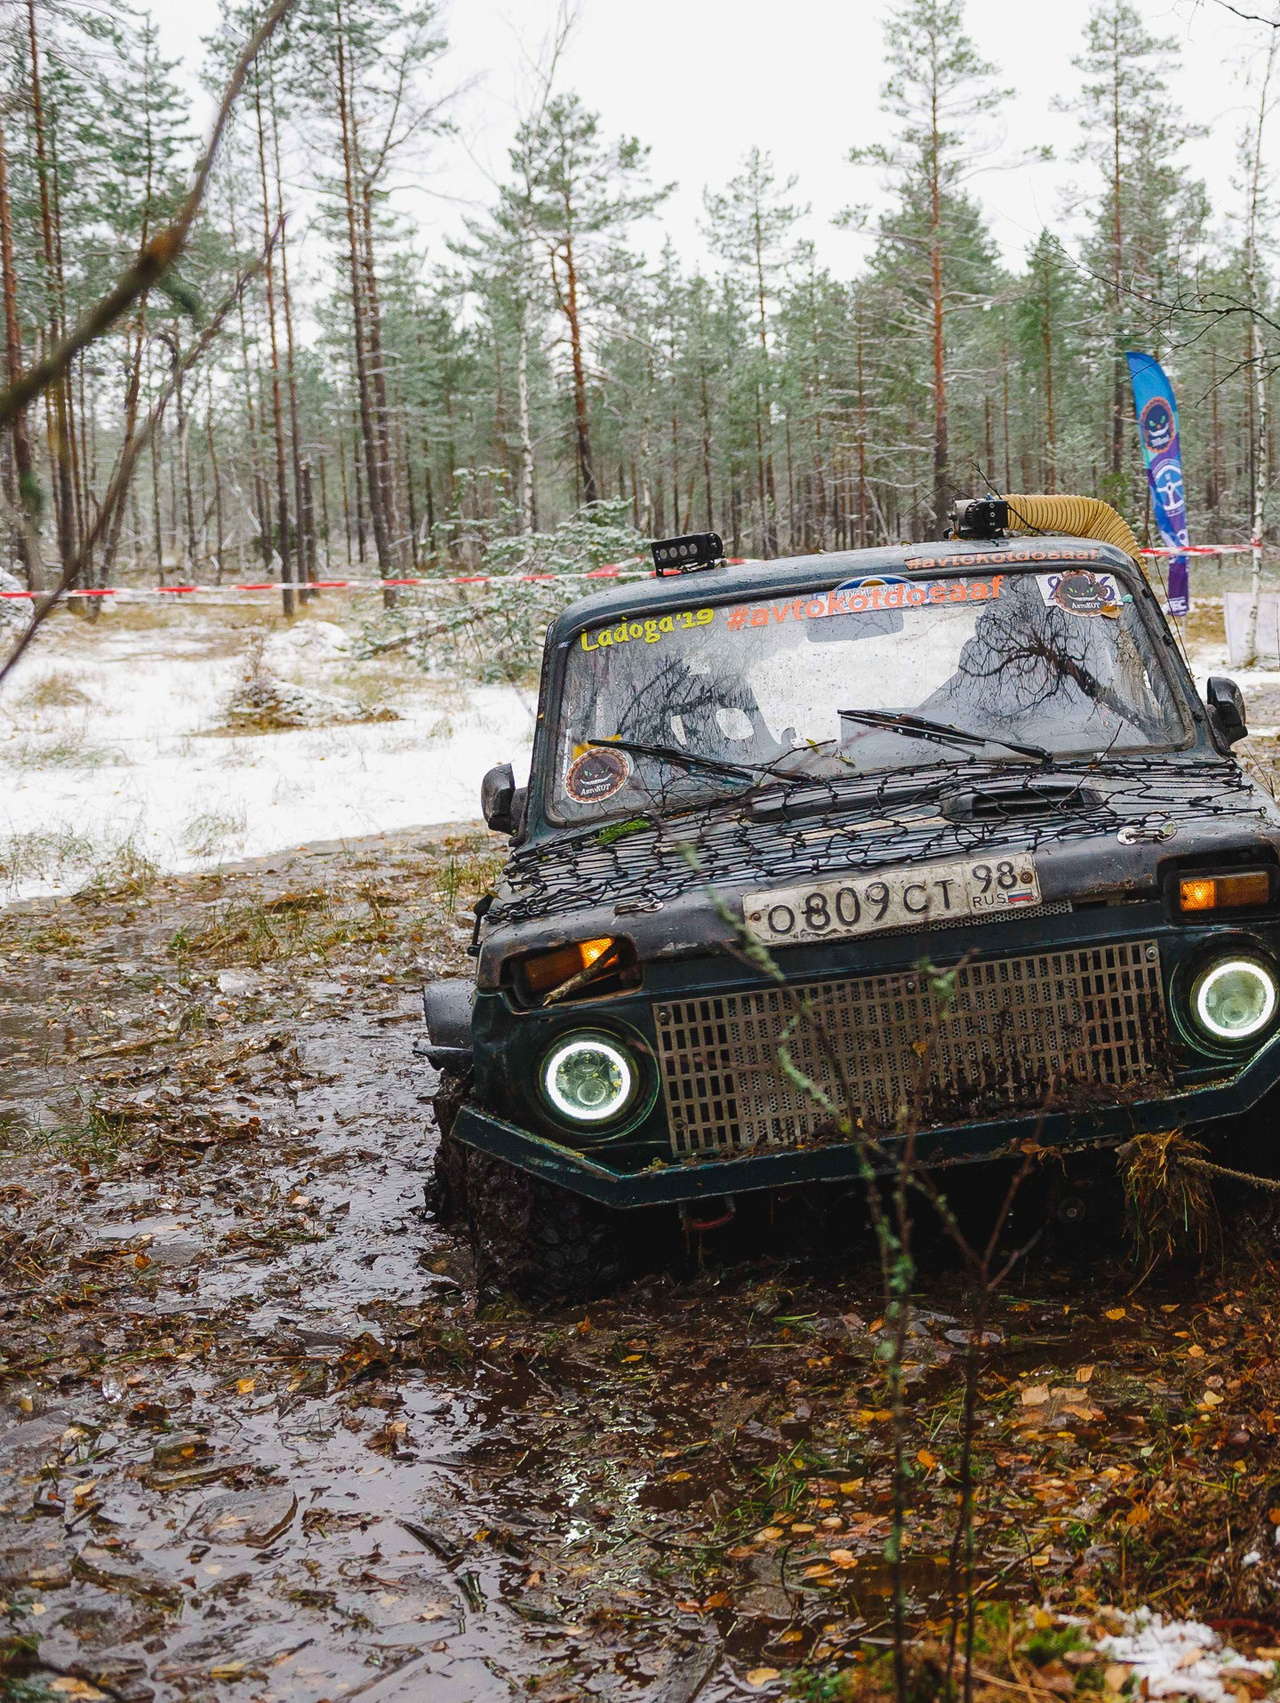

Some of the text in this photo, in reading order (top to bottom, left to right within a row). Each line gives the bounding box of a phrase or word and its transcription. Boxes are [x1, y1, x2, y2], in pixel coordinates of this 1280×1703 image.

[906, 549, 1099, 570] #avtokotdosaaf
[727, 575, 1004, 631] #avtokotdosaaf
[580, 608, 714, 652] Ladoga'19
[971, 860, 1018, 894] 98
[972, 893, 1006, 907] RUS
